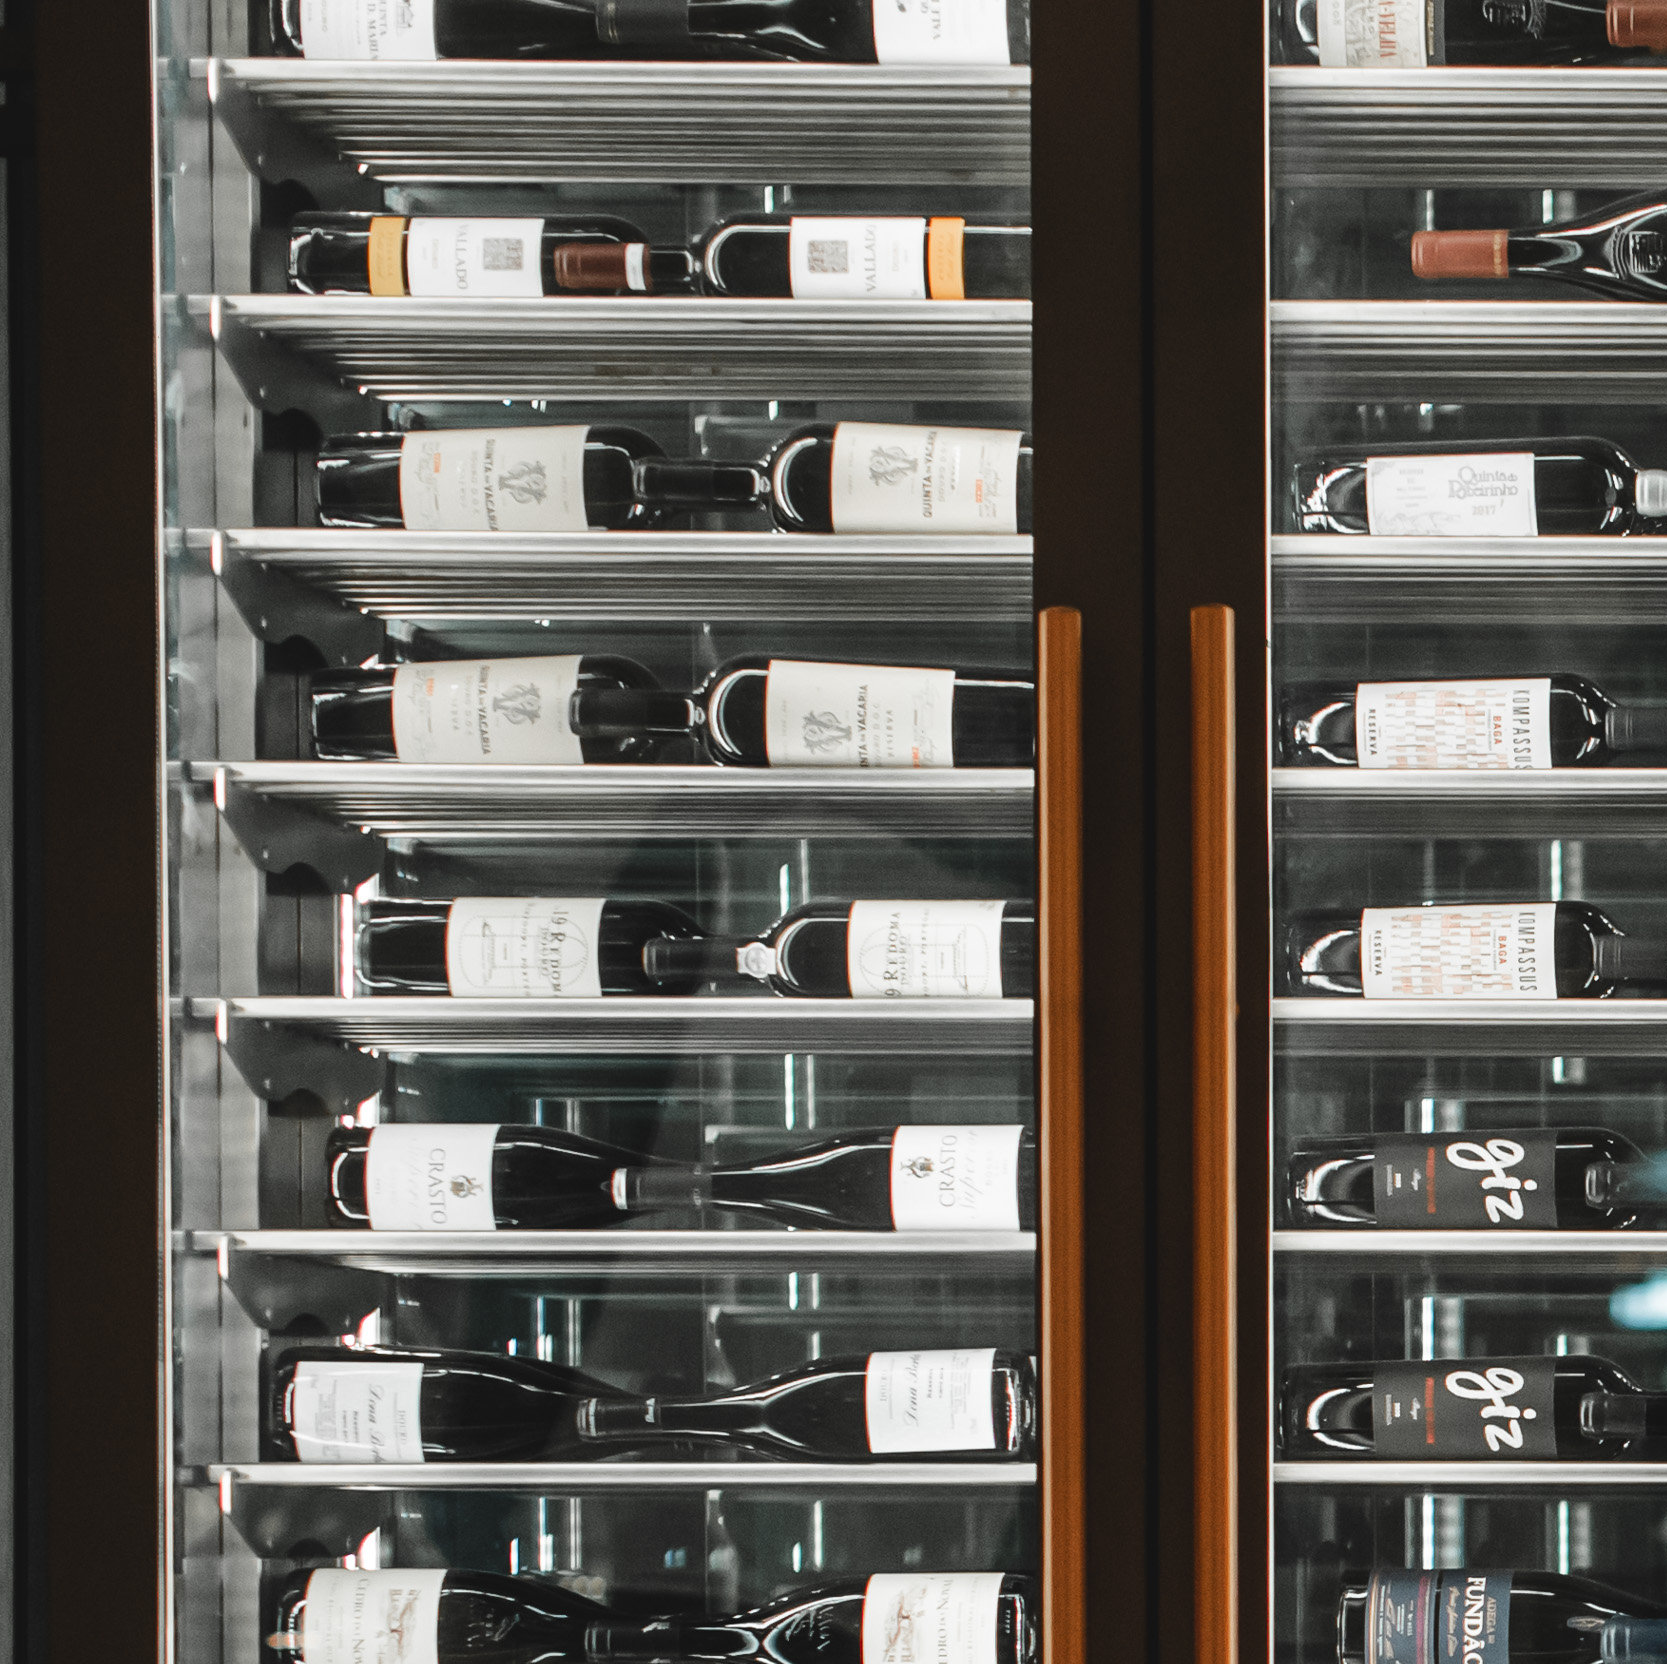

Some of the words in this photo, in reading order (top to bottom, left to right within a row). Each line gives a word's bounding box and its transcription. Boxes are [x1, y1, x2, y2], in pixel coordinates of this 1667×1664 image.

[455, 224, 469, 290] VALLADO
[865, 225, 877, 292] VALLADO
[923, 476, 933, 518] QUINTA
[1458, 465, 1506, 482] Quinta
[485, 487, 498, 531] VACARIA
[1472, 504, 1496, 515] 2017
[859, 684, 868, 731] VACARIA
[1493, 716, 1502, 744] BAGA
[1512, 690, 1533, 770] KOMPASSUS
[479, 708, 490, 755] VACARIA
[1368, 709, 1378, 755] RESERVA
[883, 913, 900, 981] REDOMA
[1374, 930, 1383, 976] RESERVA
[1498, 936, 1507, 964] BAGA
[1517, 912, 1538, 992] KOMPASSUS
[428, 1148, 447, 1224] CRASTO
[939, 1134, 958, 1207] CRASTO
[1446, 1139, 1538, 1223] giz
[1445, 1368, 1537, 1451] giz
[353, 1578, 368, 1620] CEDRO
[1486, 1597, 1497, 1633] ADEGA
